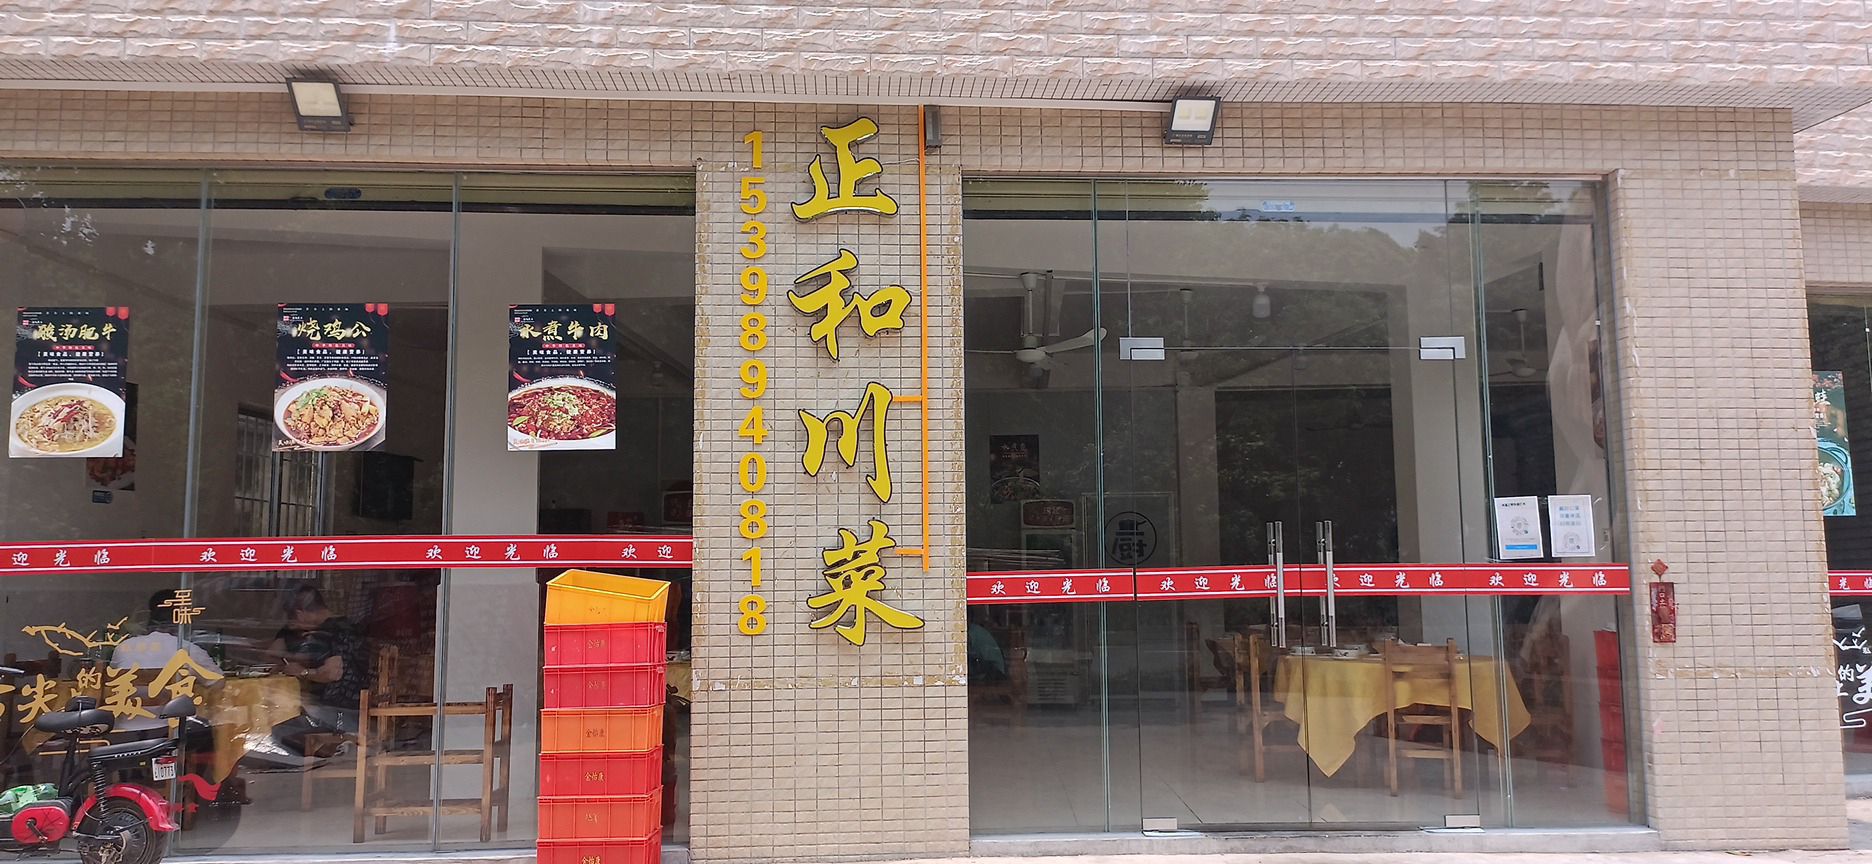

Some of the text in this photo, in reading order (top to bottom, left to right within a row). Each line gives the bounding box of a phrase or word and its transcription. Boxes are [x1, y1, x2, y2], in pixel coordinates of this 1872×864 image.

[36, 322, 117, 342] 酸汤肥牛
[297, 317, 372, 340] 烧鸡公
[518, 320, 609, 341] 水煮牛肉
[737, 130, 768, 637] 15398940818
[786, 116, 925, 646] 正和川菜
[12, 548, 111, 567] 迎光临
[199, 545, 337, 563] 欢迎光临
[425, 544, 559, 560] 欢迎光临
[621, 544, 674, 560] 欢迎
[990, 577, 1110, 595] 欢迎光临
[1159, 573, 1277, 591] 欢迎光临
[1488, 571, 1607, 588] 欢迎光临
